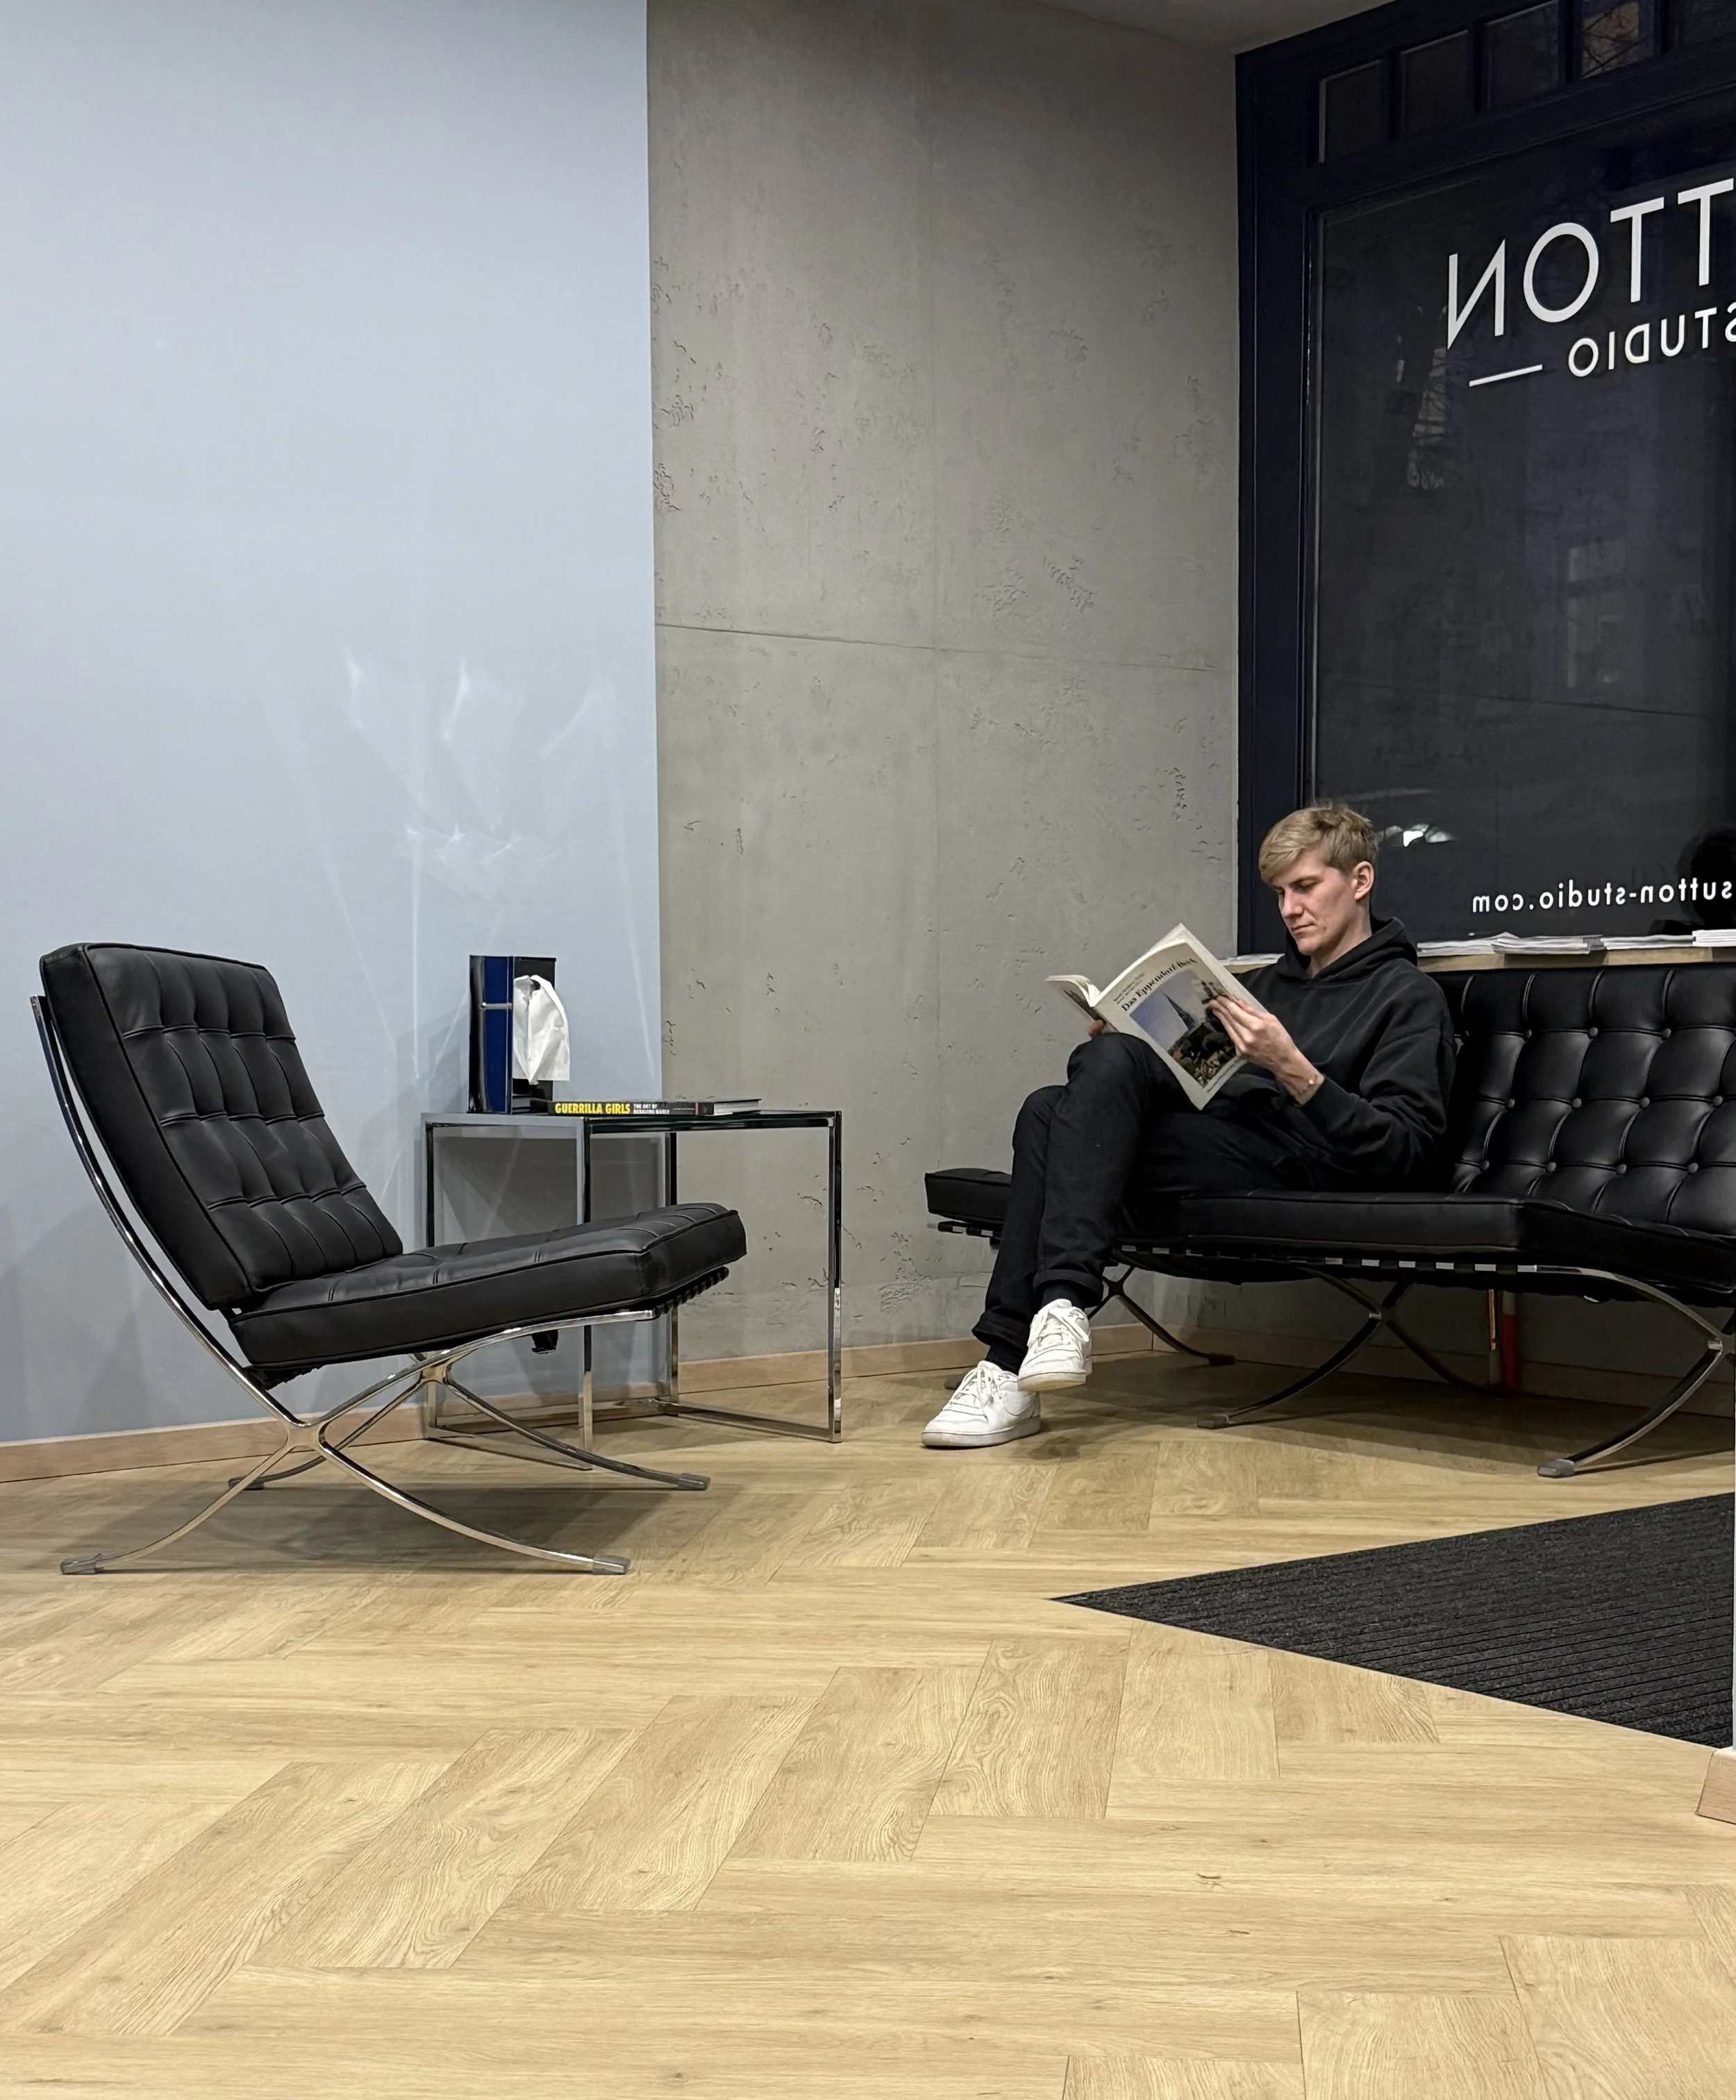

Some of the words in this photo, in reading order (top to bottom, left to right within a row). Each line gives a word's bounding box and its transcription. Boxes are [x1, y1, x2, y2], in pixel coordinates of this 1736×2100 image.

[1121, 997, 1137, 1012] Das
[1135, 963, 1176, 997] Eppendorf
[555, 1103, 603, 1115] GUERRILLA
[605, 1103, 631, 1115] GIRLS
